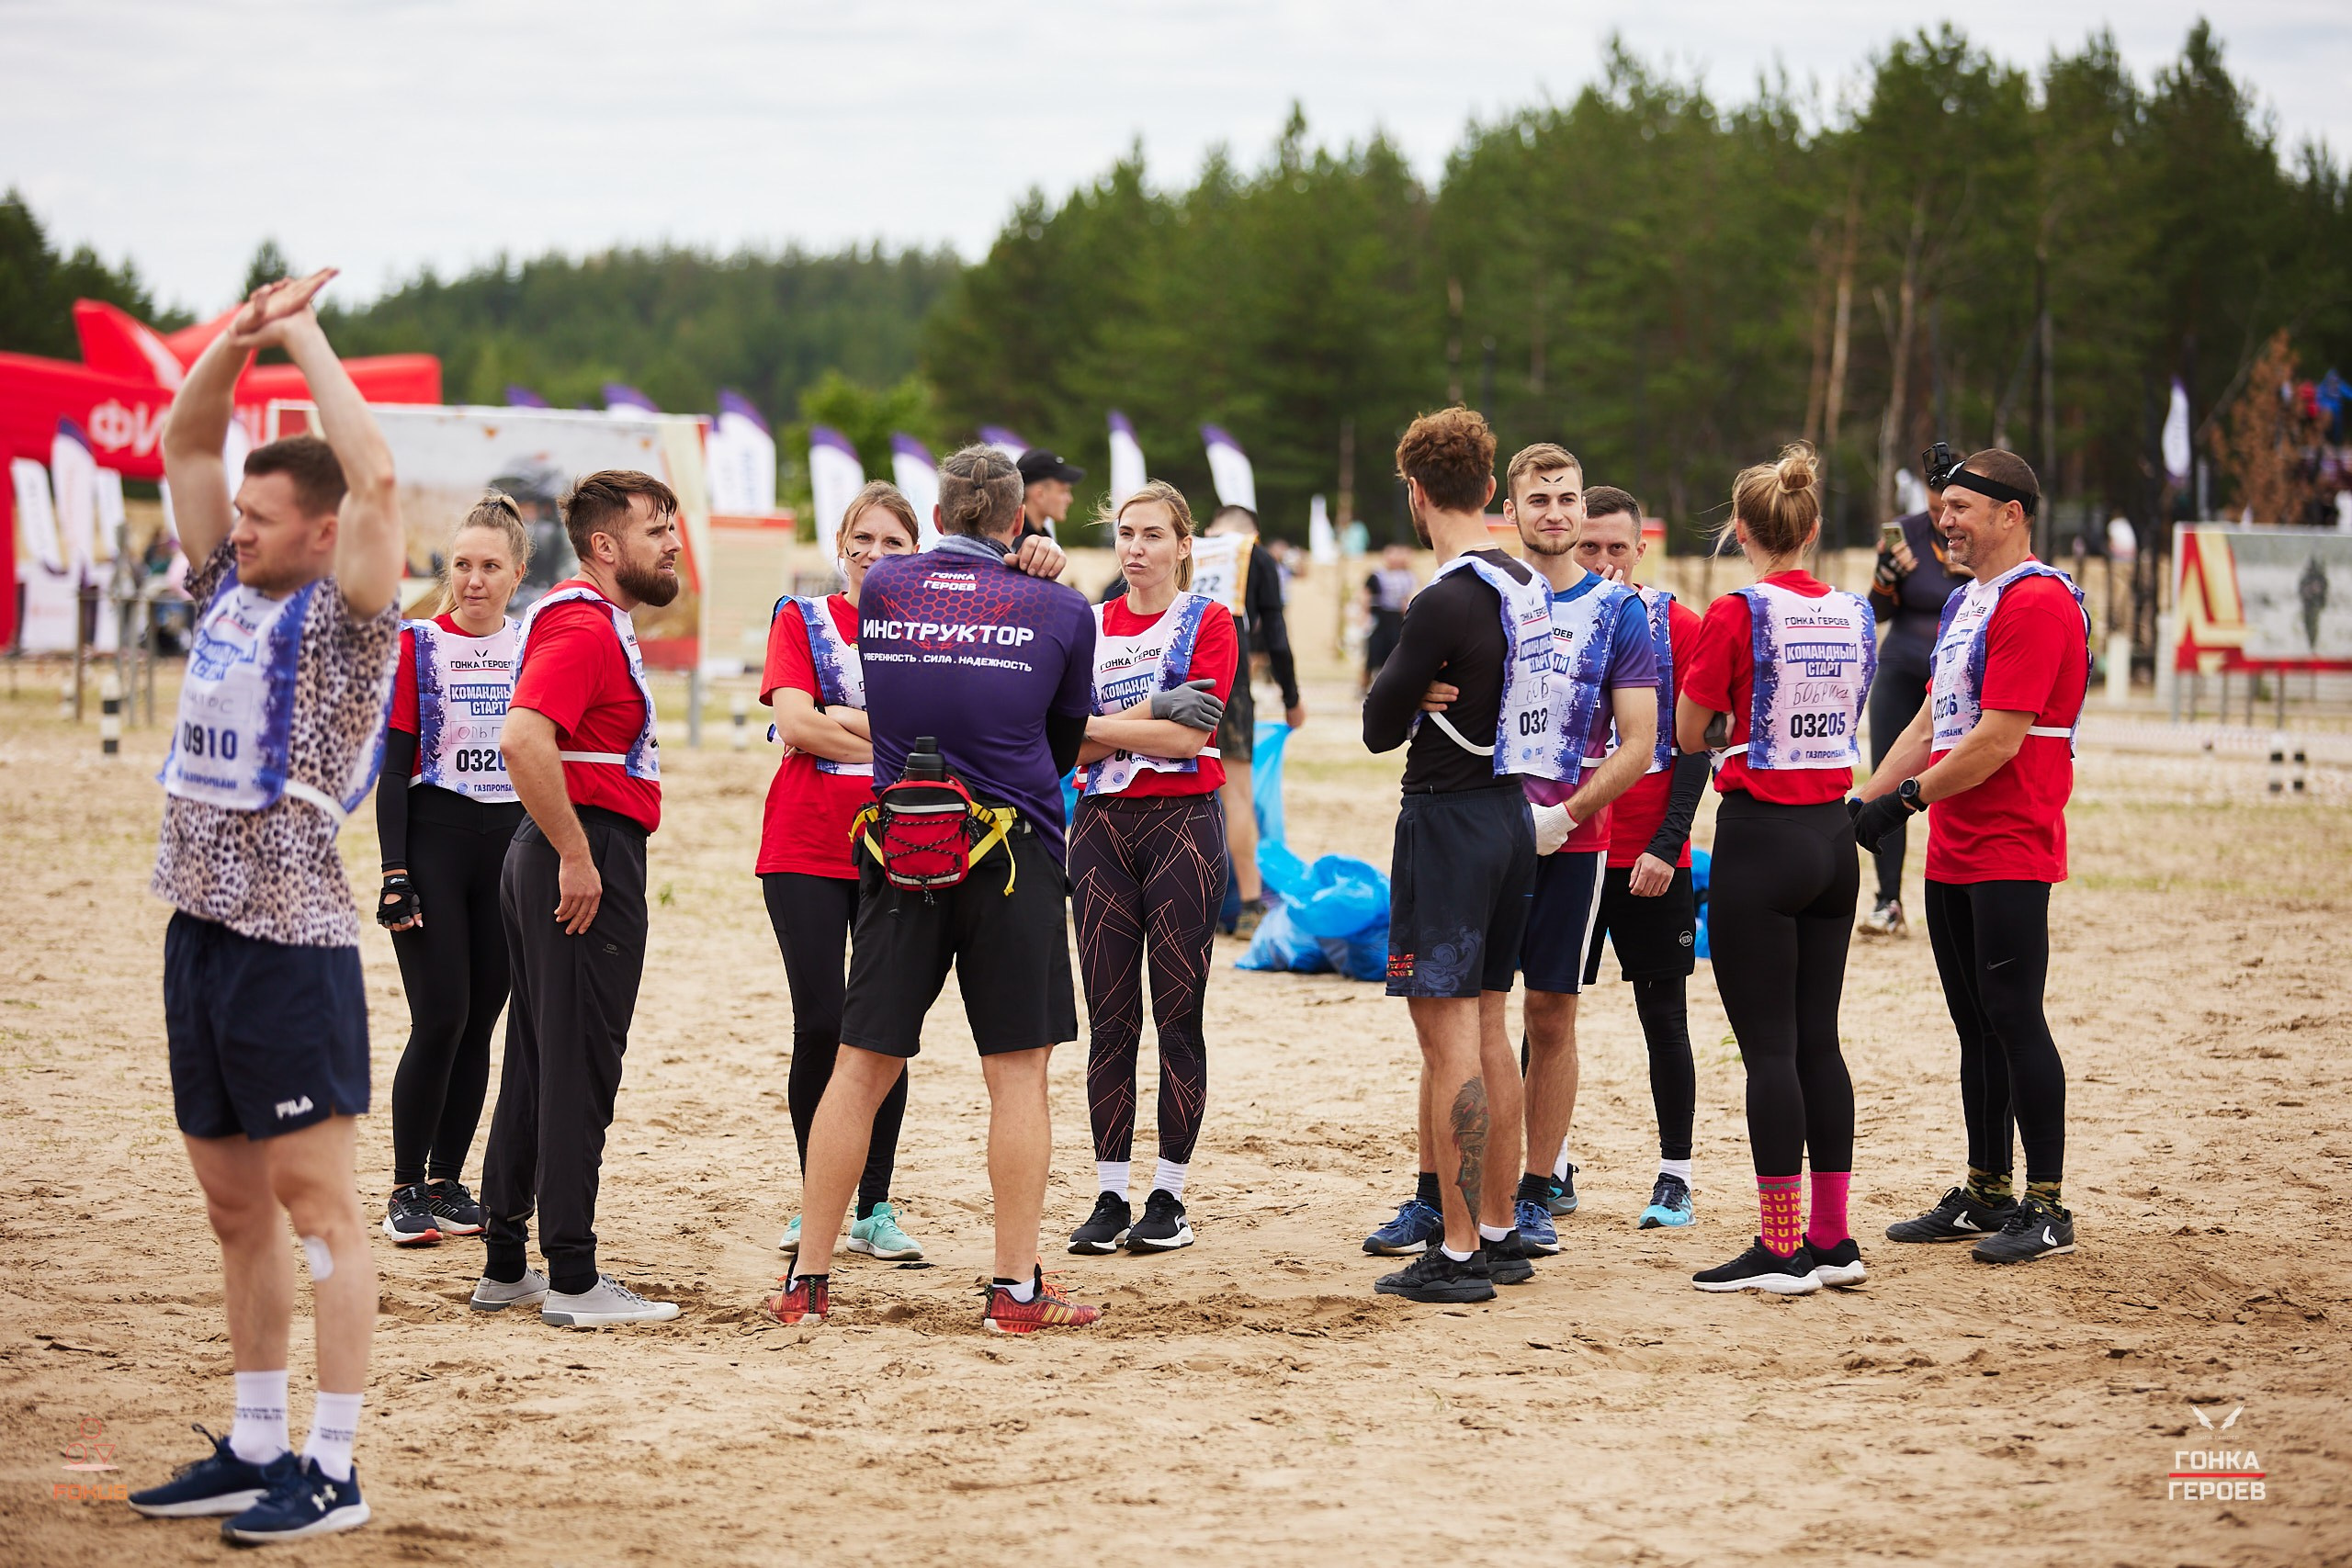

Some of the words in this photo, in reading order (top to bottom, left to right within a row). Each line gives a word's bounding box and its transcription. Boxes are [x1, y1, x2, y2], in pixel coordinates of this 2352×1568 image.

[922, 580, 977, 592] ГЕРОЕВ
[1784, 616, 1815, 626] ГОНКА
[1817, 616, 1849, 626] ГЕРОЕВ
[863, 618, 1035, 647] ИНСТРУКТОР
[1786, 643, 1856, 661] КОМАНДНЫЙ
[450, 660, 481, 669] ГОНКА
[864, 652, 917, 662] УВЕРЕННОСТЬ
[923, 654, 952, 663] СИЛА
[958, 656, 1033, 672] НАДЕЖНОСТЬ
[1100, 657, 1132, 671] ГОНКА
[1134, 648, 1162, 662] ГЕРОЕ
[1807, 661, 1840, 676] СТАРТ
[472, 701, 504, 715] СТАРТ
[1791, 712, 1846, 739] 03205
[473, 784, 514, 792] ГАЗПРОМБА
[276, 1095, 314, 1120] FILA
[1760, 1190, 1801, 1201] RUN
[1762, 1201, 1801, 1213] RUN
[1763, 1214, 1802, 1225] RUN
[1764, 1226, 1802, 1237] RUN
[1765, 1238, 1804, 1254] RUN
